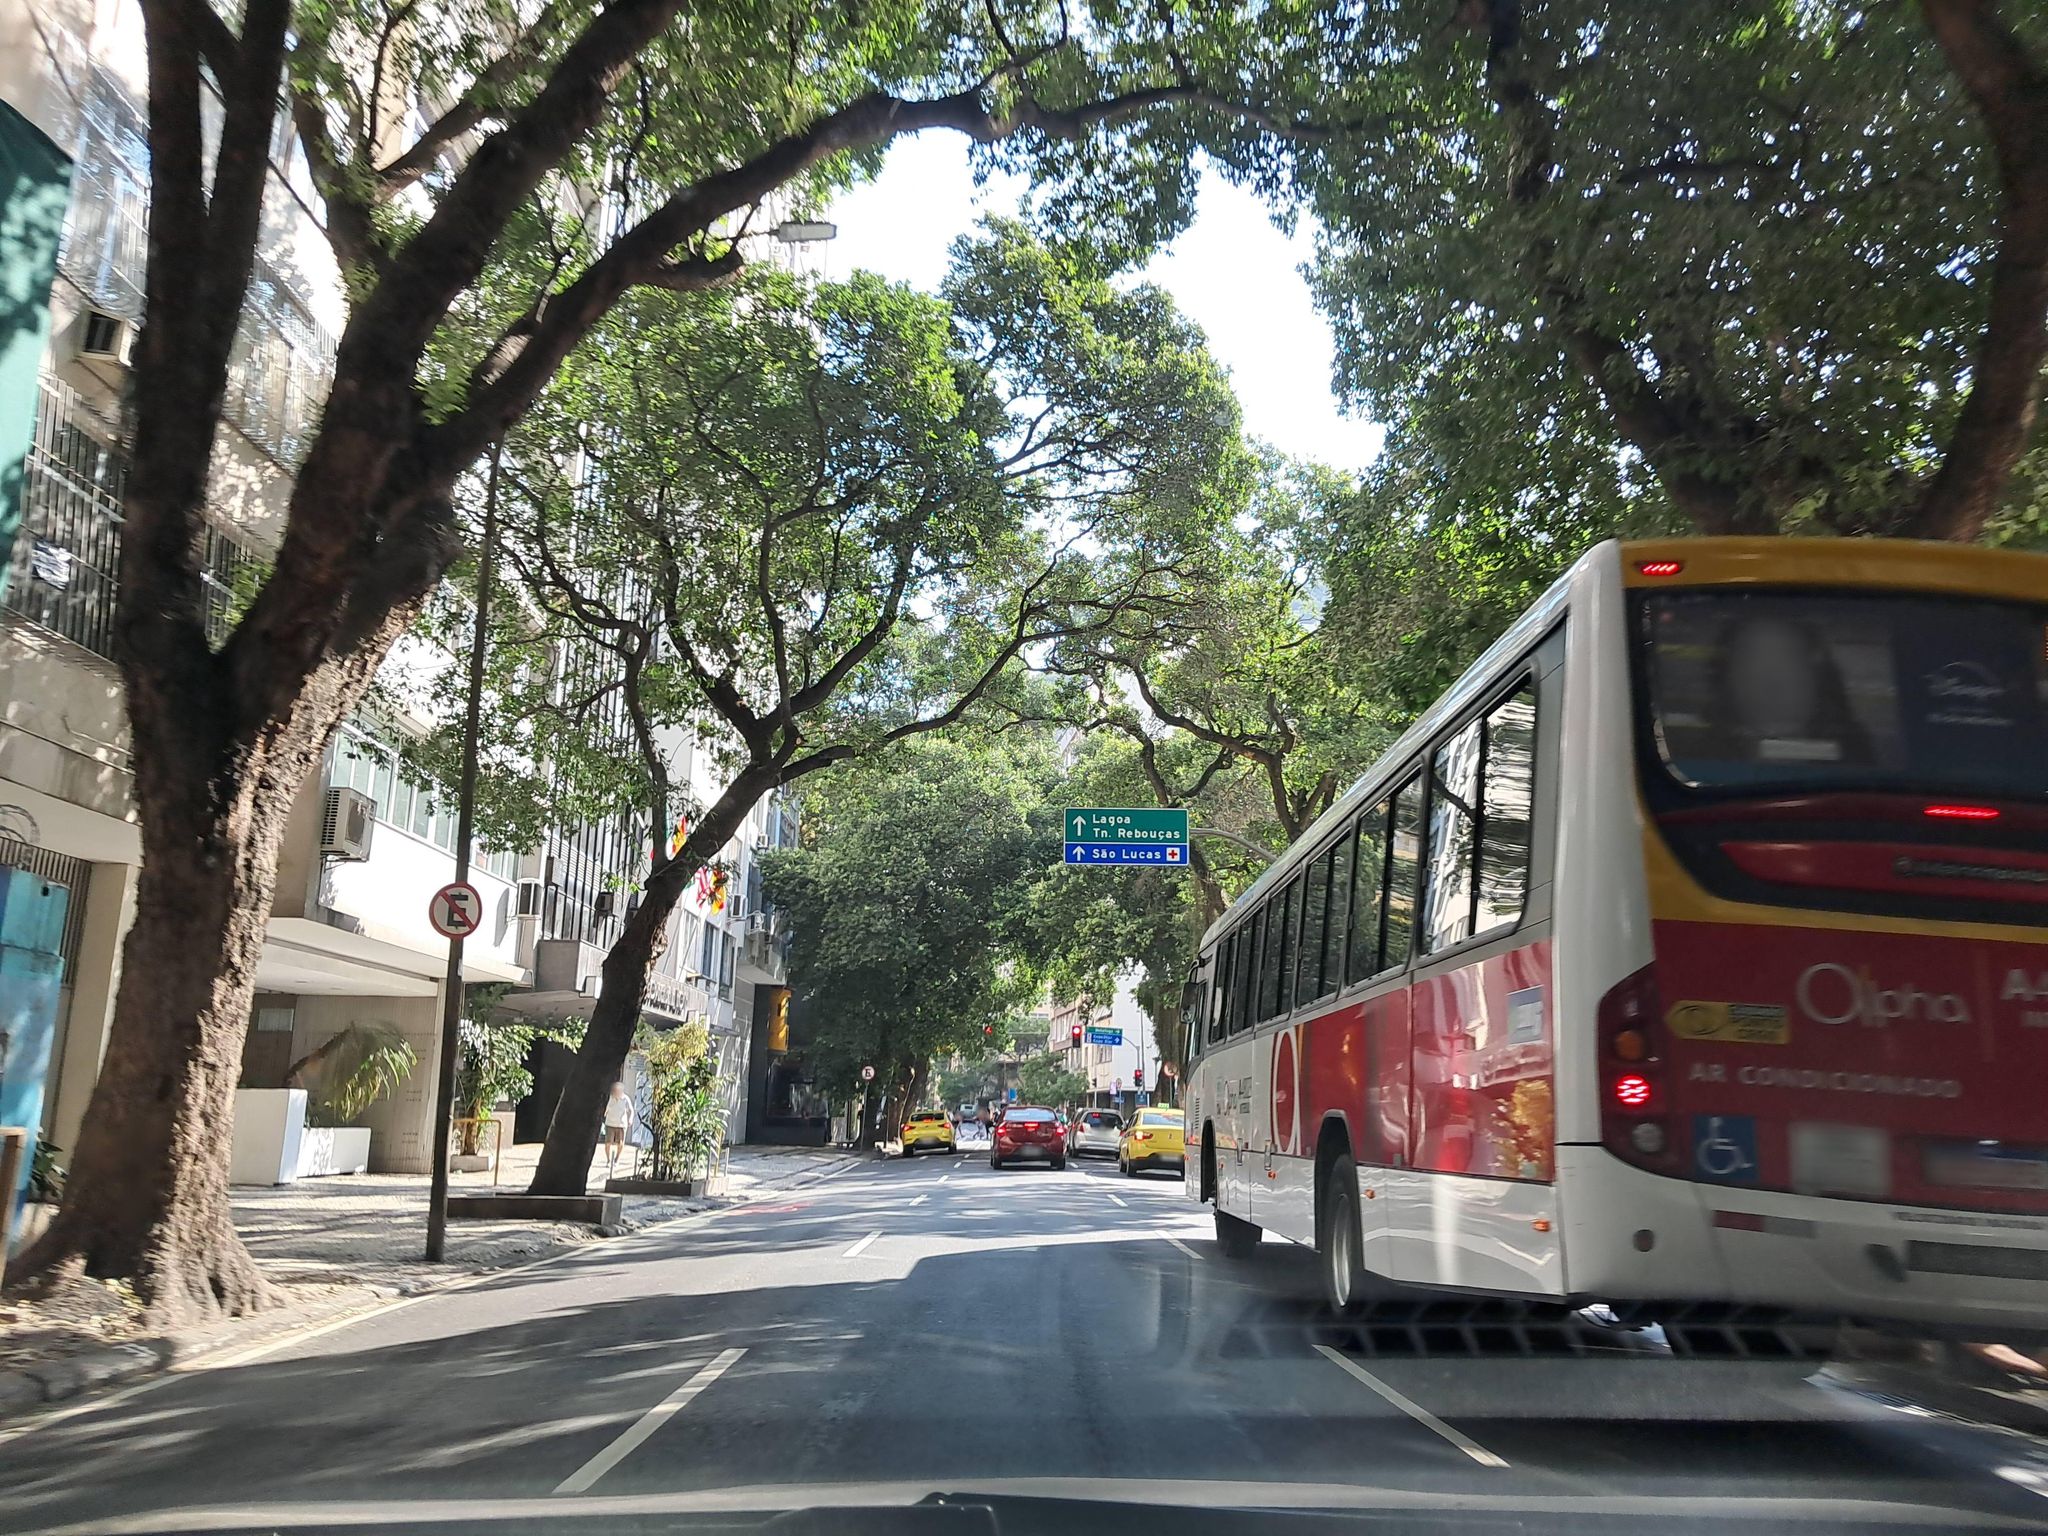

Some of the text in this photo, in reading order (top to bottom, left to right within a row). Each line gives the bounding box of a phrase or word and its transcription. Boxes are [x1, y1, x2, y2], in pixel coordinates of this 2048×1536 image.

[1092, 814, 1131, 826] Lagoa
[1092, 828, 1181, 840] Tn. Rebouças
[1092, 848, 1162, 859] São Lucas
[1688, 1062, 1728, 1083] AR
